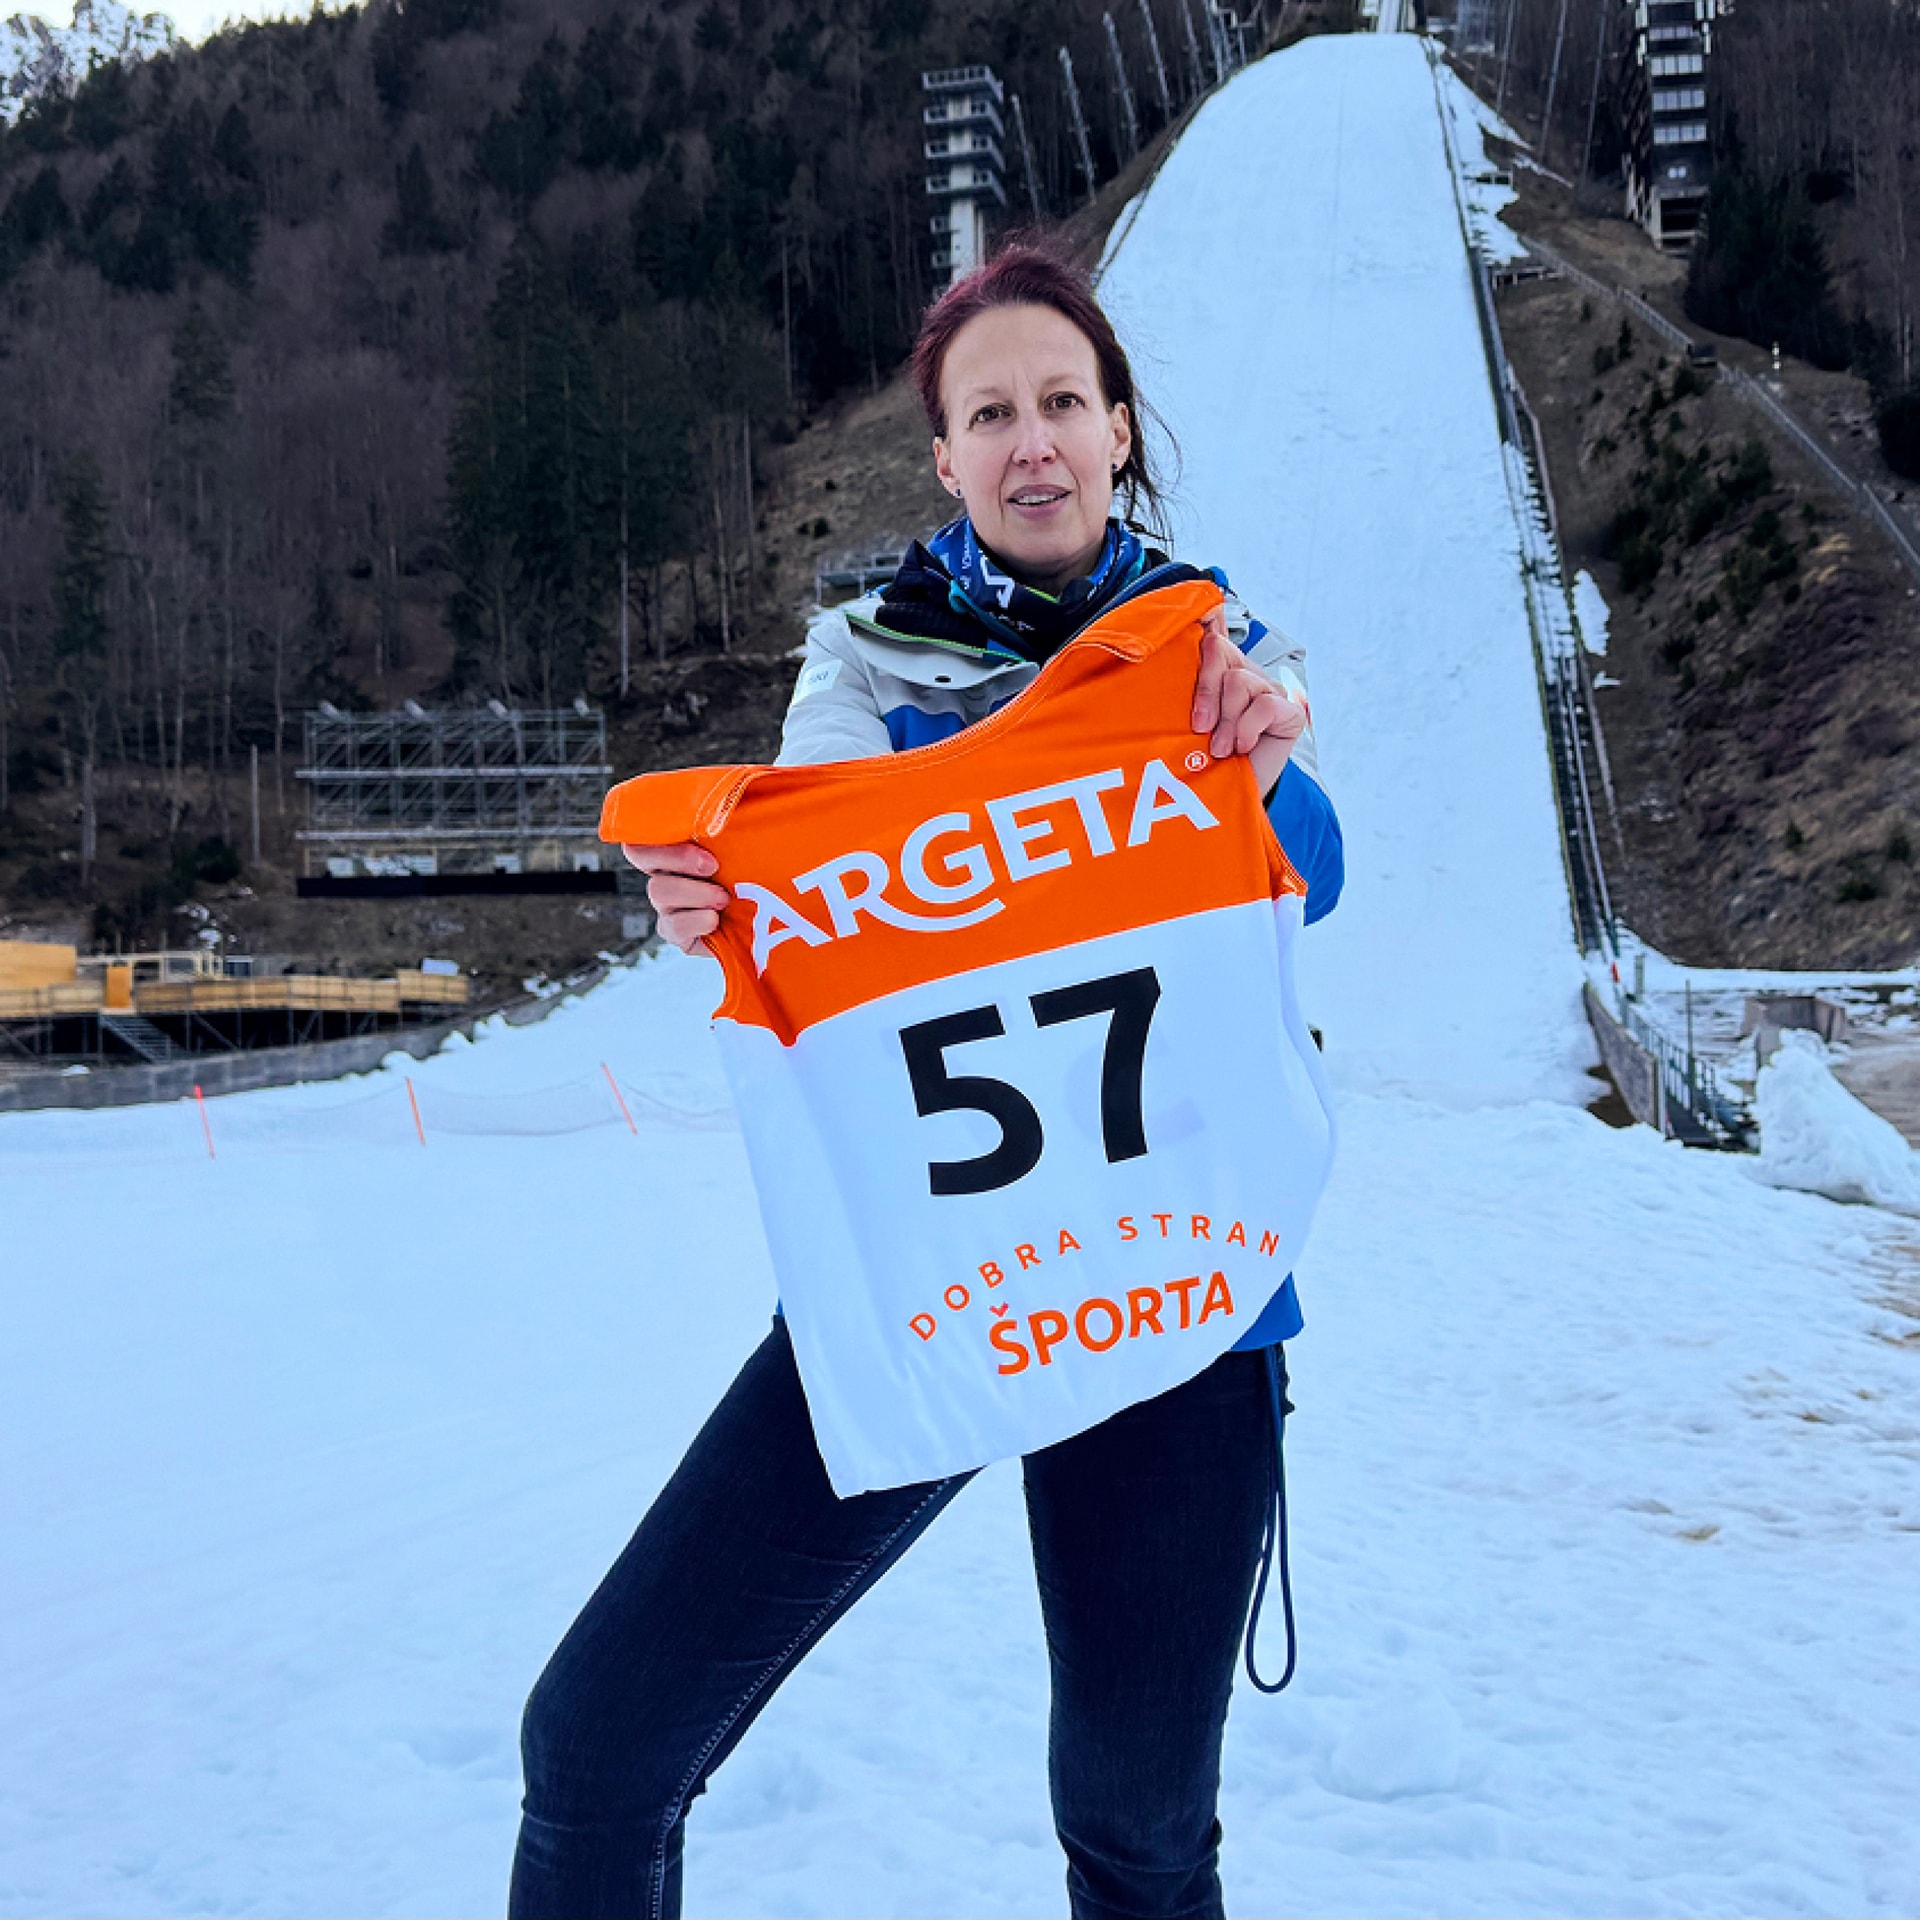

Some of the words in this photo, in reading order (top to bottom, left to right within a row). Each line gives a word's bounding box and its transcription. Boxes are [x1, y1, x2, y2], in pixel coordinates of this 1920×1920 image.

[899, 966, 1161, 1195] 57
[909, 1229, 1081, 1341] DOBRA
[1117, 1213, 1279, 1256] STRAN
[989, 1271, 1235, 1376] ŠPORTA
